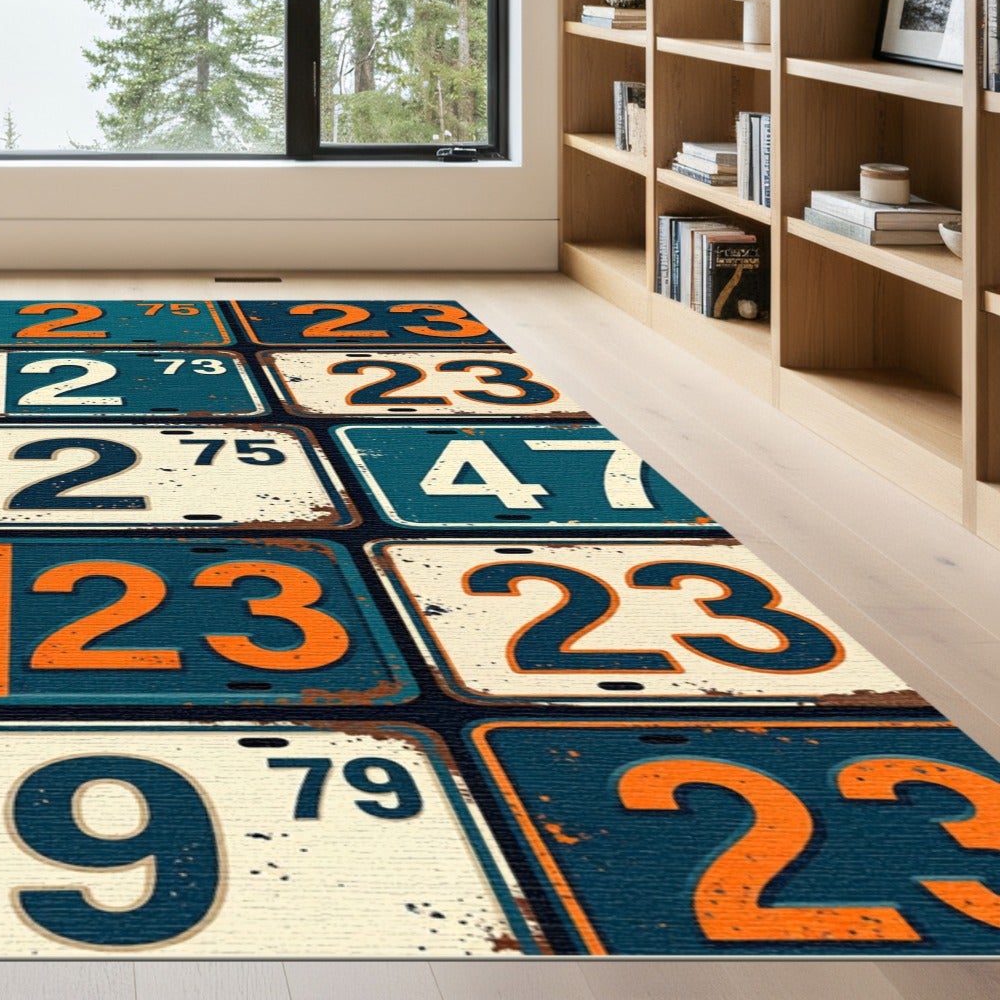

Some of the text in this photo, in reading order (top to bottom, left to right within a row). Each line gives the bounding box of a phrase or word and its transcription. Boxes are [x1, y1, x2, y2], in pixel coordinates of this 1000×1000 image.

[137, 303, 200, 316] 75
[289, 303, 489, 337] 23
[153, 359, 227, 375] 73
[327, 359, 560, 406] 23
[180, 439, 286, 466] 75
[419, 440, 654, 509] 47
[30, 561, 350, 671] 23
[461, 560, 846, 675] 23
[267, 757, 425, 821] 79
